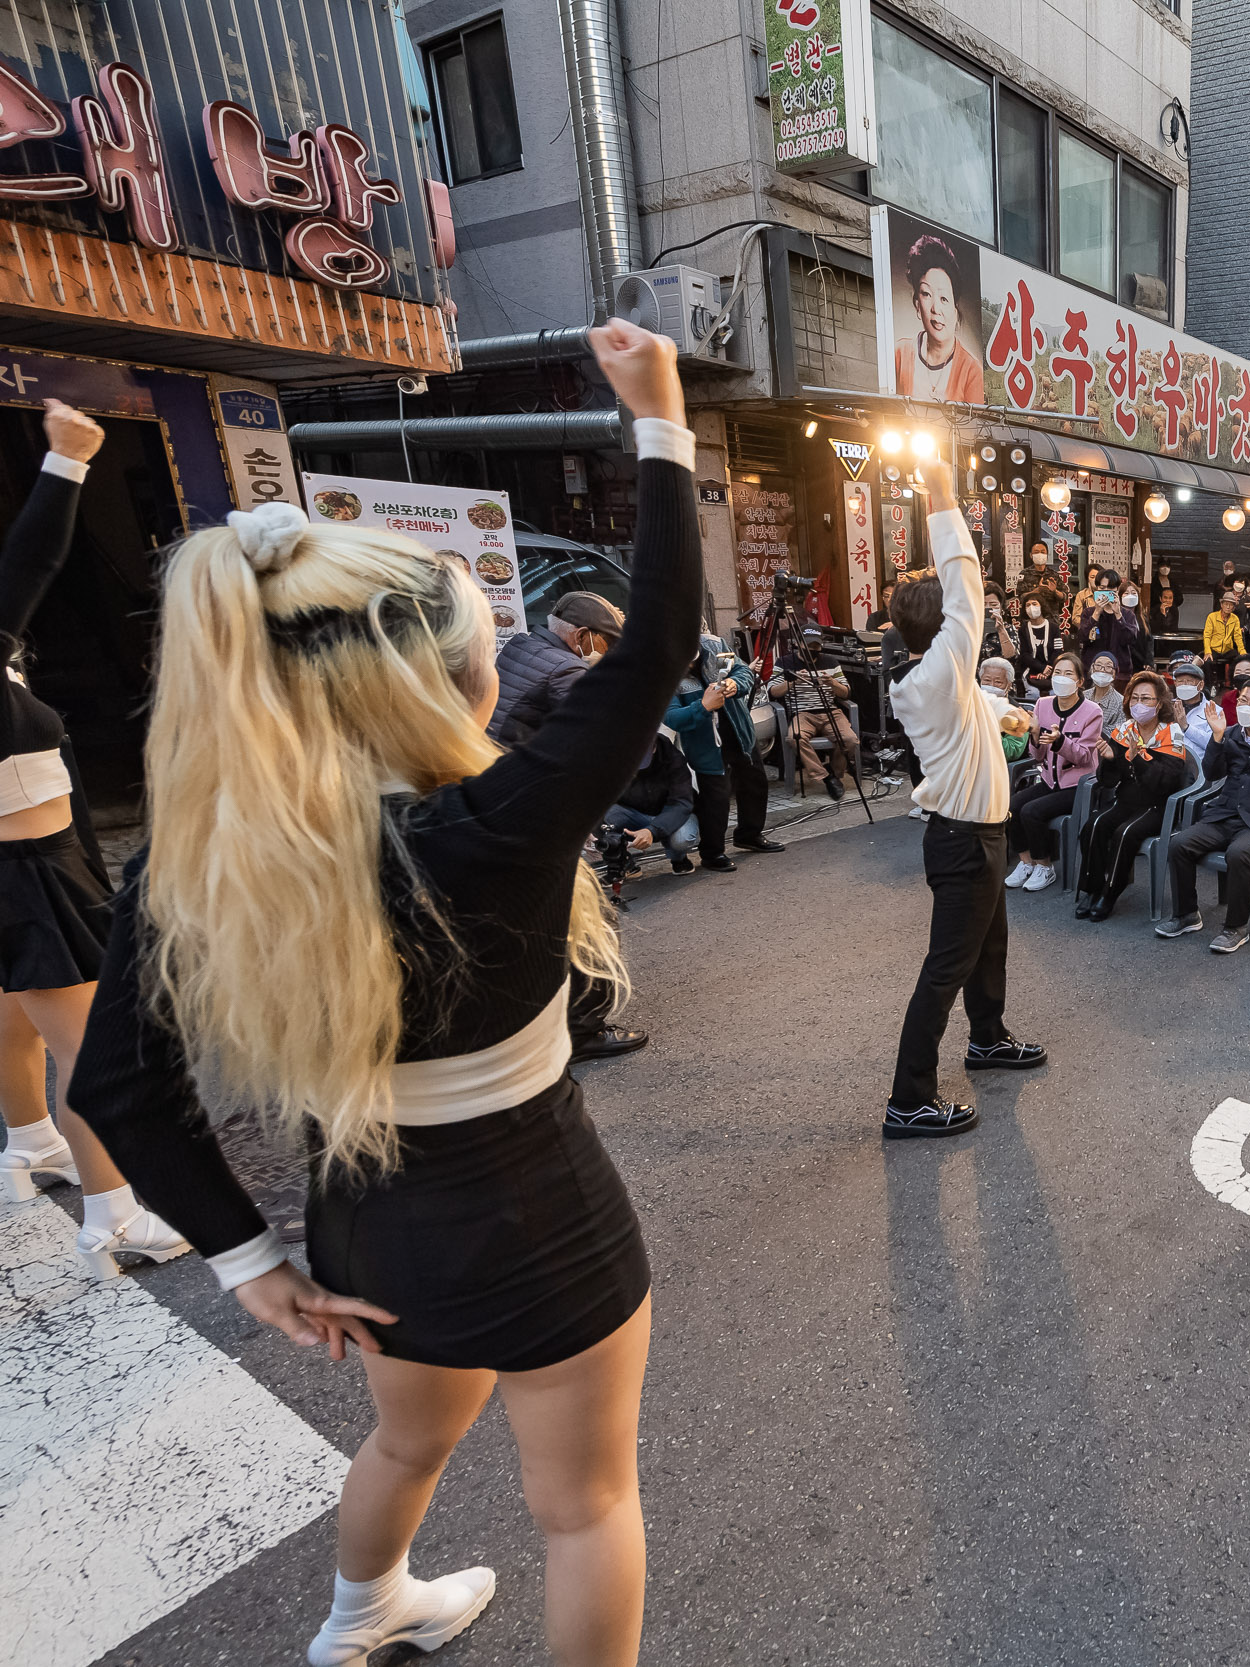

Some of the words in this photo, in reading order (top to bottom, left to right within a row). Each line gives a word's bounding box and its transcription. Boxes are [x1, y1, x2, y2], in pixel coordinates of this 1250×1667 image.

[781, 109, 838, 137] 02.454.3517
[777, 130, 844, 160] 010.3757.2749
[653, 276, 679, 286] SAMSUNG
[239, 408, 265, 426] 40
[833, 441, 871, 462] TERRA
[706, 490, 720, 501] 38
[385, 517, 450, 534] (추천메뉴)
[483, 533, 498, 541] 꼬막
